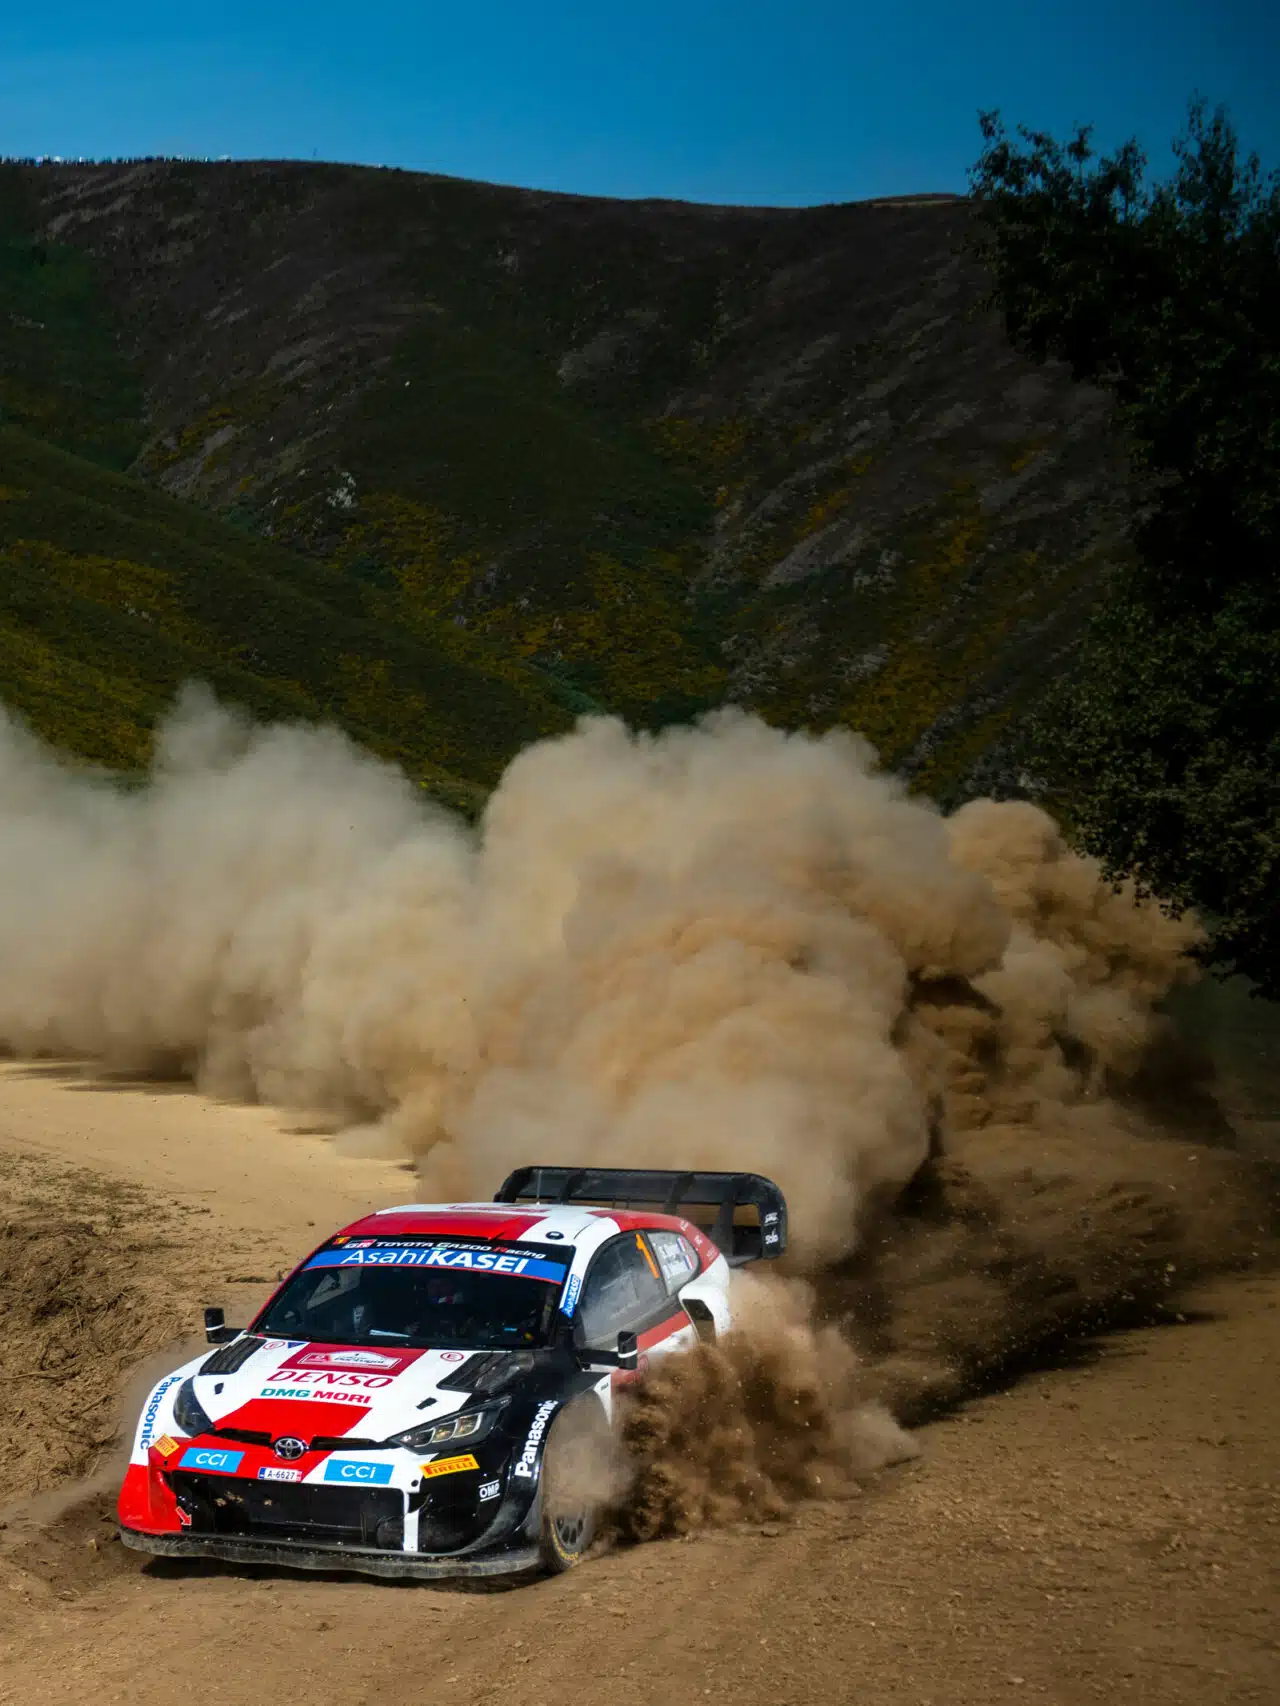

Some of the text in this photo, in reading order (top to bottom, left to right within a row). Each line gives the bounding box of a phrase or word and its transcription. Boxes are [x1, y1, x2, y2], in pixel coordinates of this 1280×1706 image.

[436, 1242, 492, 1251] GAZOO
[492, 1246, 547, 1259] Racing
[340, 1249, 530, 1274] AsahiKASEI
[266, 1370, 394, 1388] DENSO
[260, 1388, 372, 1404] DMG MORI
[140, 1376, 183, 1450] Panasonic
[514, 1400, 559, 1478] Panasonic
[267, 1470, 296, 1480] A-6627
[423, 1457, 474, 1475] PIRELLI
[479, 1482, 500, 1498] OMP
